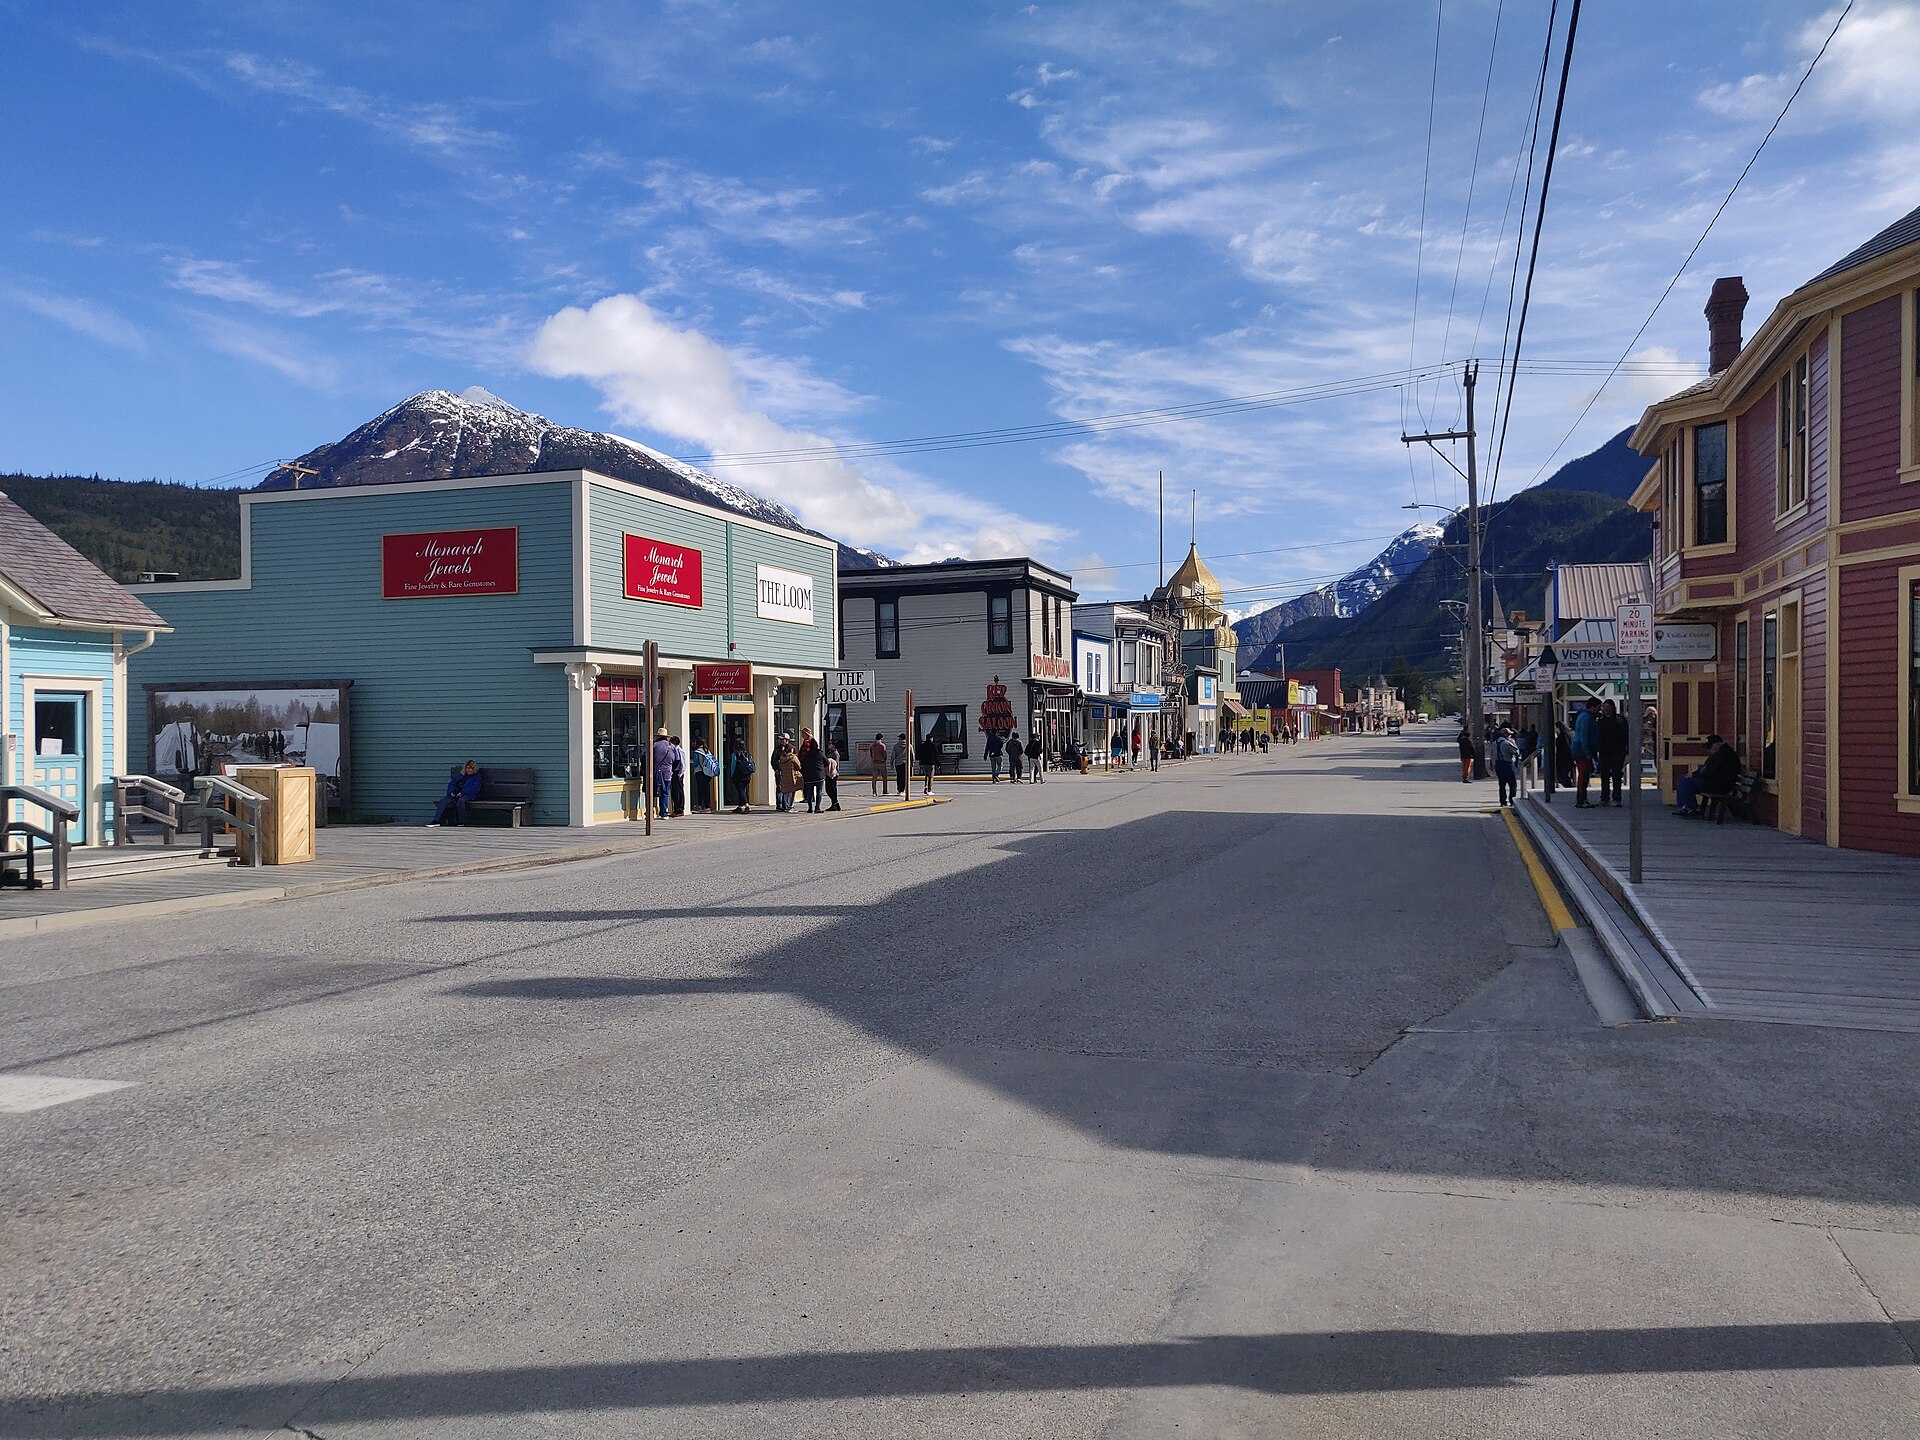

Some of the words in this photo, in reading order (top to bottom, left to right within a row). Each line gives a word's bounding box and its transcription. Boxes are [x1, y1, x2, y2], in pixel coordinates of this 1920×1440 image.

[415, 537, 483, 558] Monarch
[643, 546, 683, 569] Monarch
[424, 556, 472, 582] Jewels
[649, 564, 678, 586] Jewels
[404, 583, 418, 591] Fine
[418, 582, 440, 591] Jewelry
[440, 581, 447, 589] &
[448, 581, 463, 589] Rare
[463, 580, 496, 588] Gemstones
[637, 584, 646, 593] Fine
[645, 586, 659, 596] Jewelry
[659, 587, 664, 595] &
[663, 588, 672, 597] Rare
[759, 579, 781, 606] THE
[782, 583, 812, 611] LOOM
[1629, 610, 1640, 619] 20
[1623, 620, 1646, 629] MINUTE
[1620, 630, 1649, 638] PARKING
[1561, 648, 1604, 660] VISITOR
[707, 668, 740, 677] Monarch
[836, 671, 864, 686] THE
[712, 676, 735, 687] Jewels
[831, 687, 870, 703] LOOM
[986, 684, 1008, 701] RED
[981, 700, 1012, 716] ONION
[978, 716, 1018, 732] SALOON
